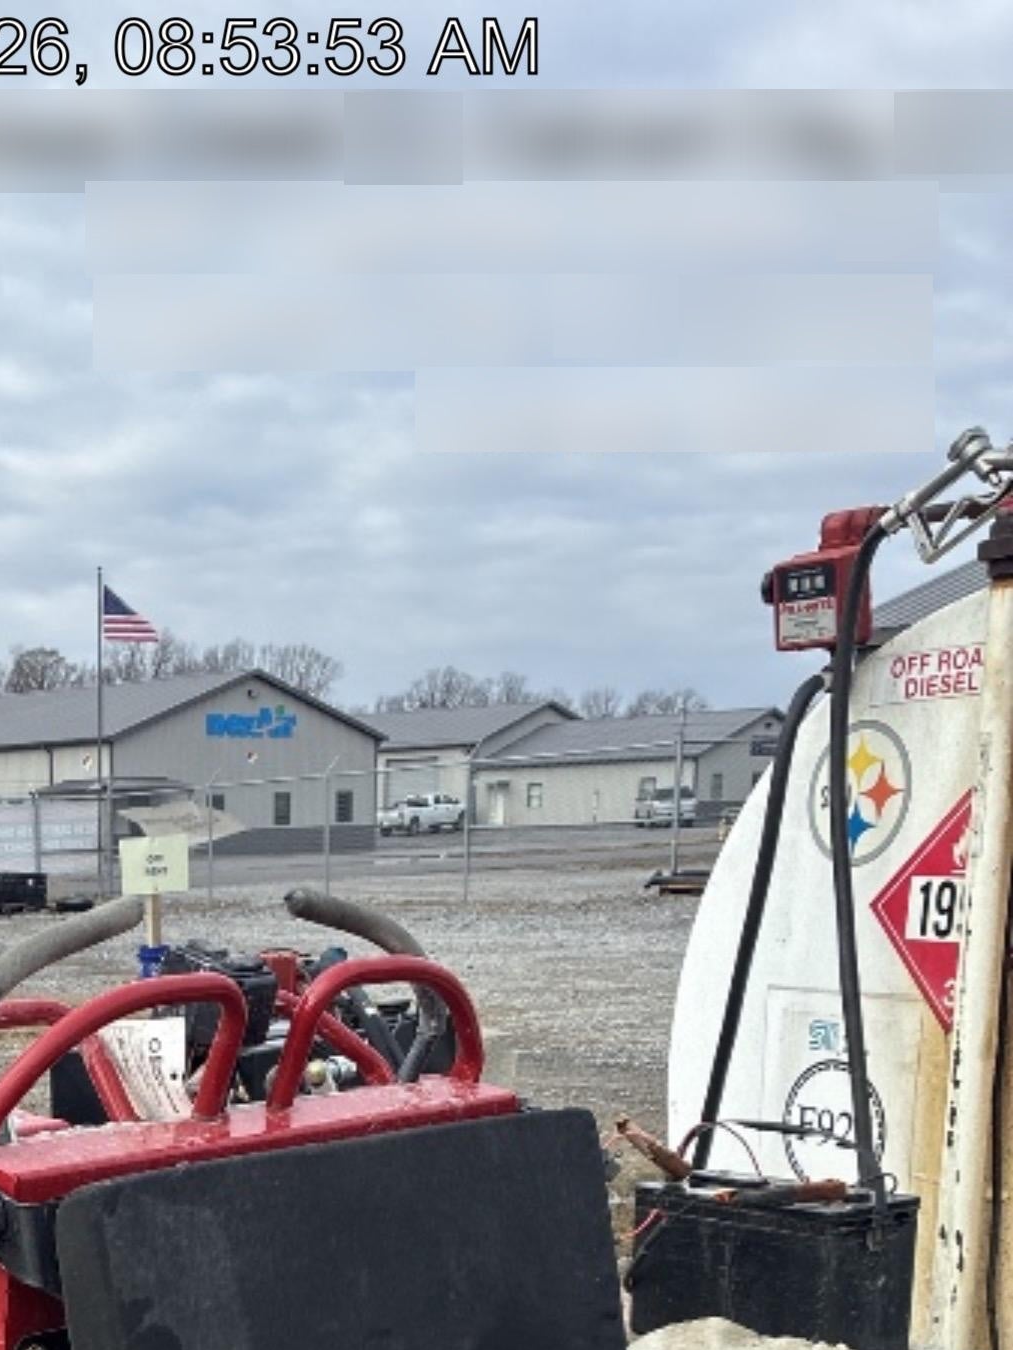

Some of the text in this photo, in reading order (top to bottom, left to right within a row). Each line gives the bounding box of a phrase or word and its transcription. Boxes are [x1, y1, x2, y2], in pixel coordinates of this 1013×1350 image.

[891, 647, 984, 679] OFF ROA
[904, 672, 978, 699] DIESEL
[799, 1106, 853, 1146] F92
